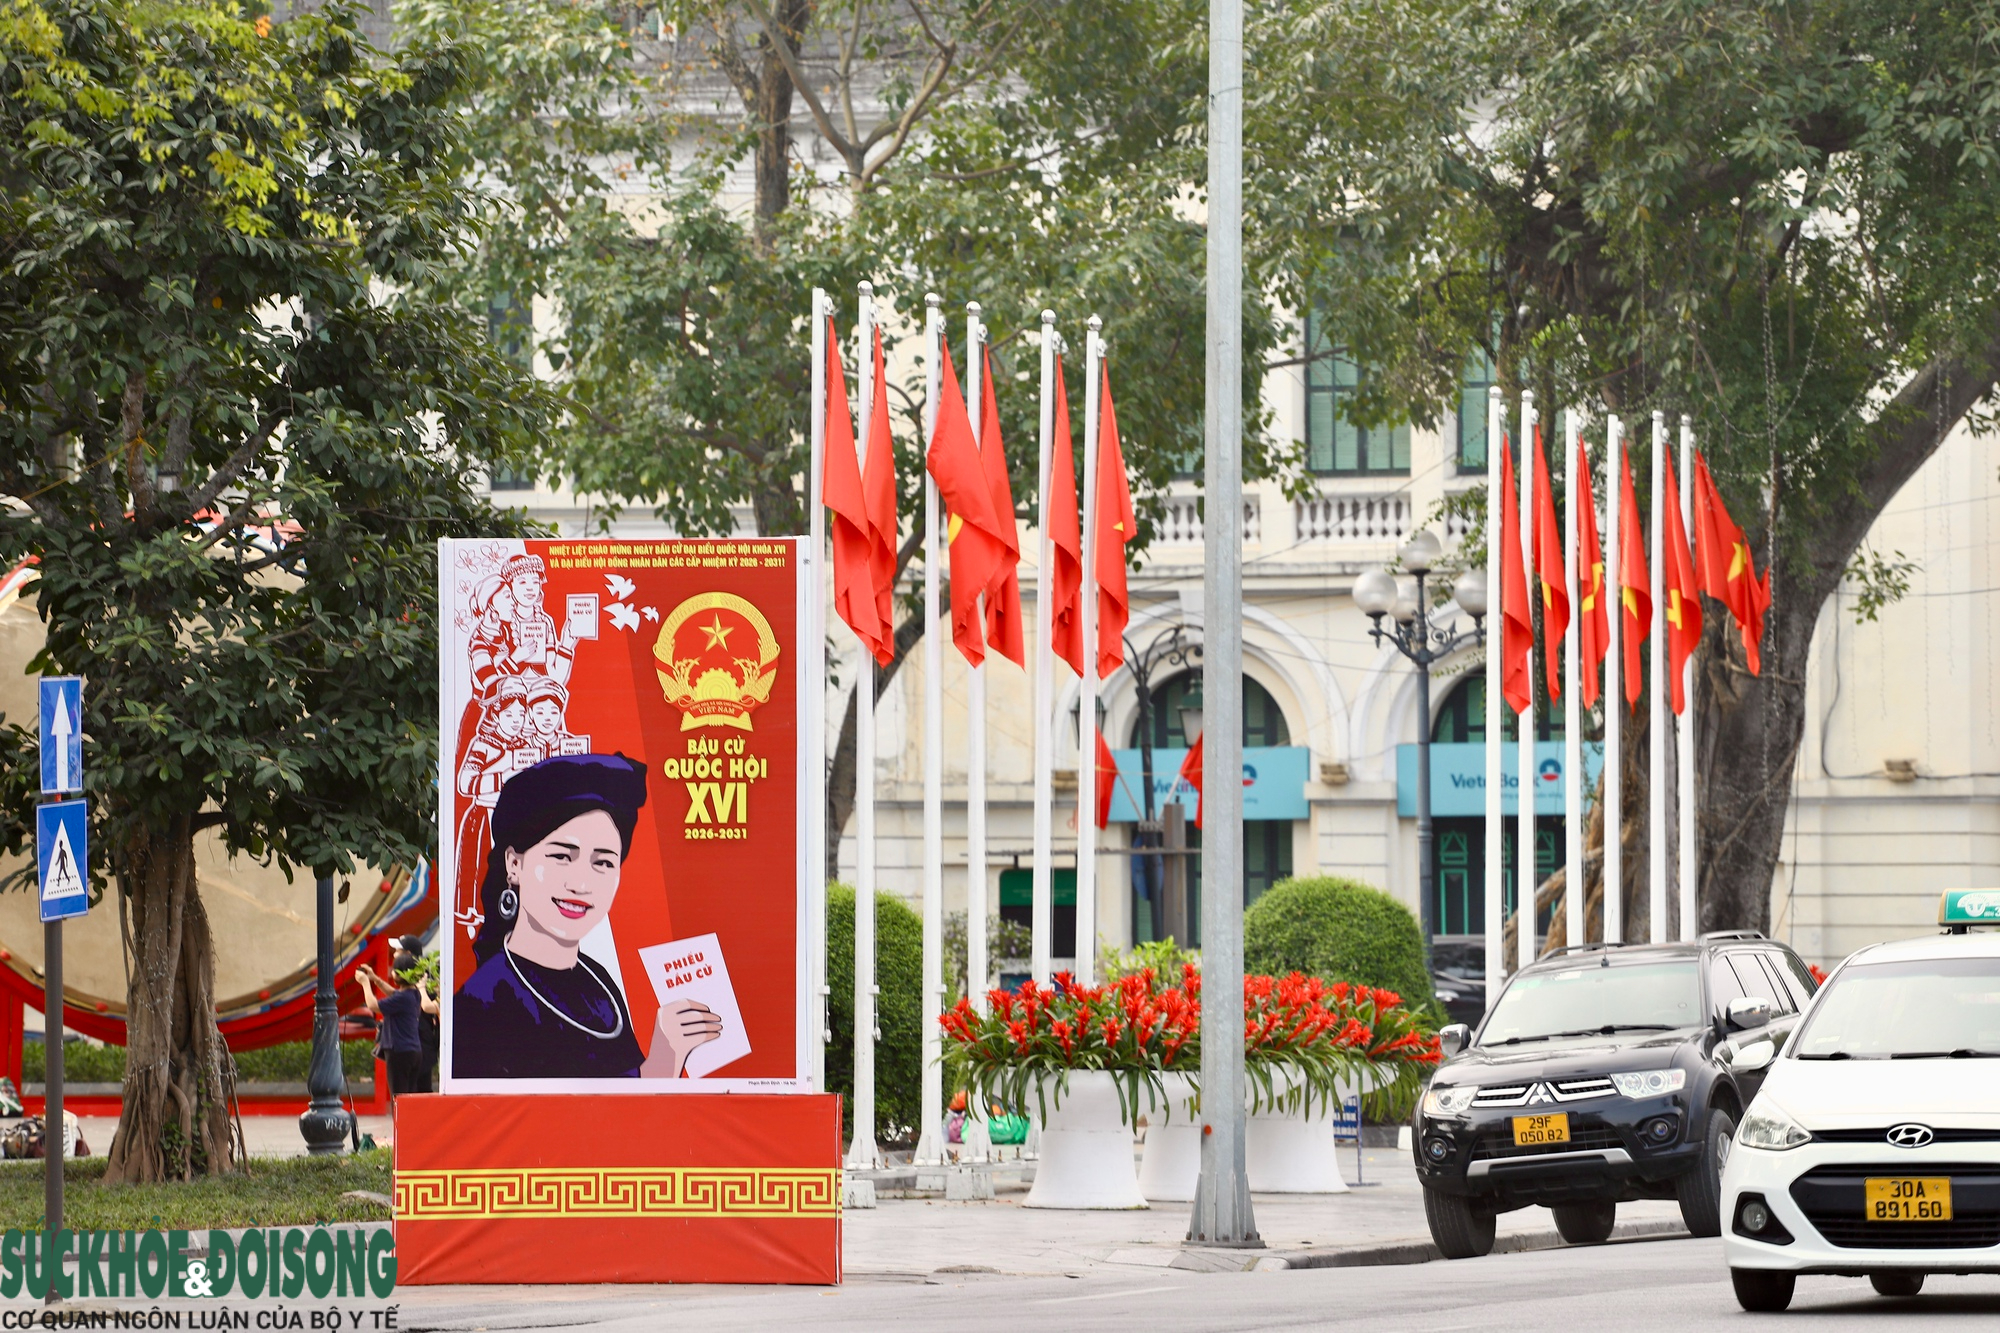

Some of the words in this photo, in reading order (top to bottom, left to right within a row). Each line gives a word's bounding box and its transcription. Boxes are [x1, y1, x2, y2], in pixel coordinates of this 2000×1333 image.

[549, 544, 571, 557] NHIỆT
[572, 544, 587, 557] LIỆT
[588, 543, 608, 555] CHÀO
[610, 543, 632, 554] MỪNG
[634, 543, 654, 554] NGÀY
[655, 542, 670, 554] BẦU
[671, 541, 683, 554] CỬ
[683, 544, 696, 556] ĐẠI
[698, 541, 715, 554] BIỂU
[716, 542, 736, 555] QUỐC
[738, 543, 750, 556] HỘI
[774, 544, 786, 554] XVI
[549, 557, 560, 568] VÀ
[561, 558, 573, 570] ĐẠI
[575, 555, 591, 568] BIỂU
[593, 557, 606, 569] HỘI
[608, 556, 628, 568] ĐỒNG
[630, 557, 650, 568] NHÂN
[652, 556, 668, 568] DÂN
[669, 556, 685, 567] CÁC
[686, 555, 701, 567] CẤP
[703, 555, 727, 569] NHIỆM
[740, 557, 758, 567] 2026
[764, 557, 785, 567] 2031!
[718, 706, 735, 714] NAM
[687, 734, 719, 756] BẦU
[723, 734, 746, 755] CỬ
[664, 754, 723, 780] QUỐC
[729, 754, 767, 784] HỘI
[684, 782, 747, 824] XVI
[684, 828, 747, 839] 2026-2031
[664, 951, 704, 973] PHIẾU
[665, 972, 693, 989] BẦU
[696, 963, 713, 979] CỬ
[1529, 1116, 1551, 1129] 29F
[1520, 1129, 1563, 1143] 050.82
[1890, 1181, 1926, 1198] 30A
[1875, 1201, 1942, 1218] 891.60
